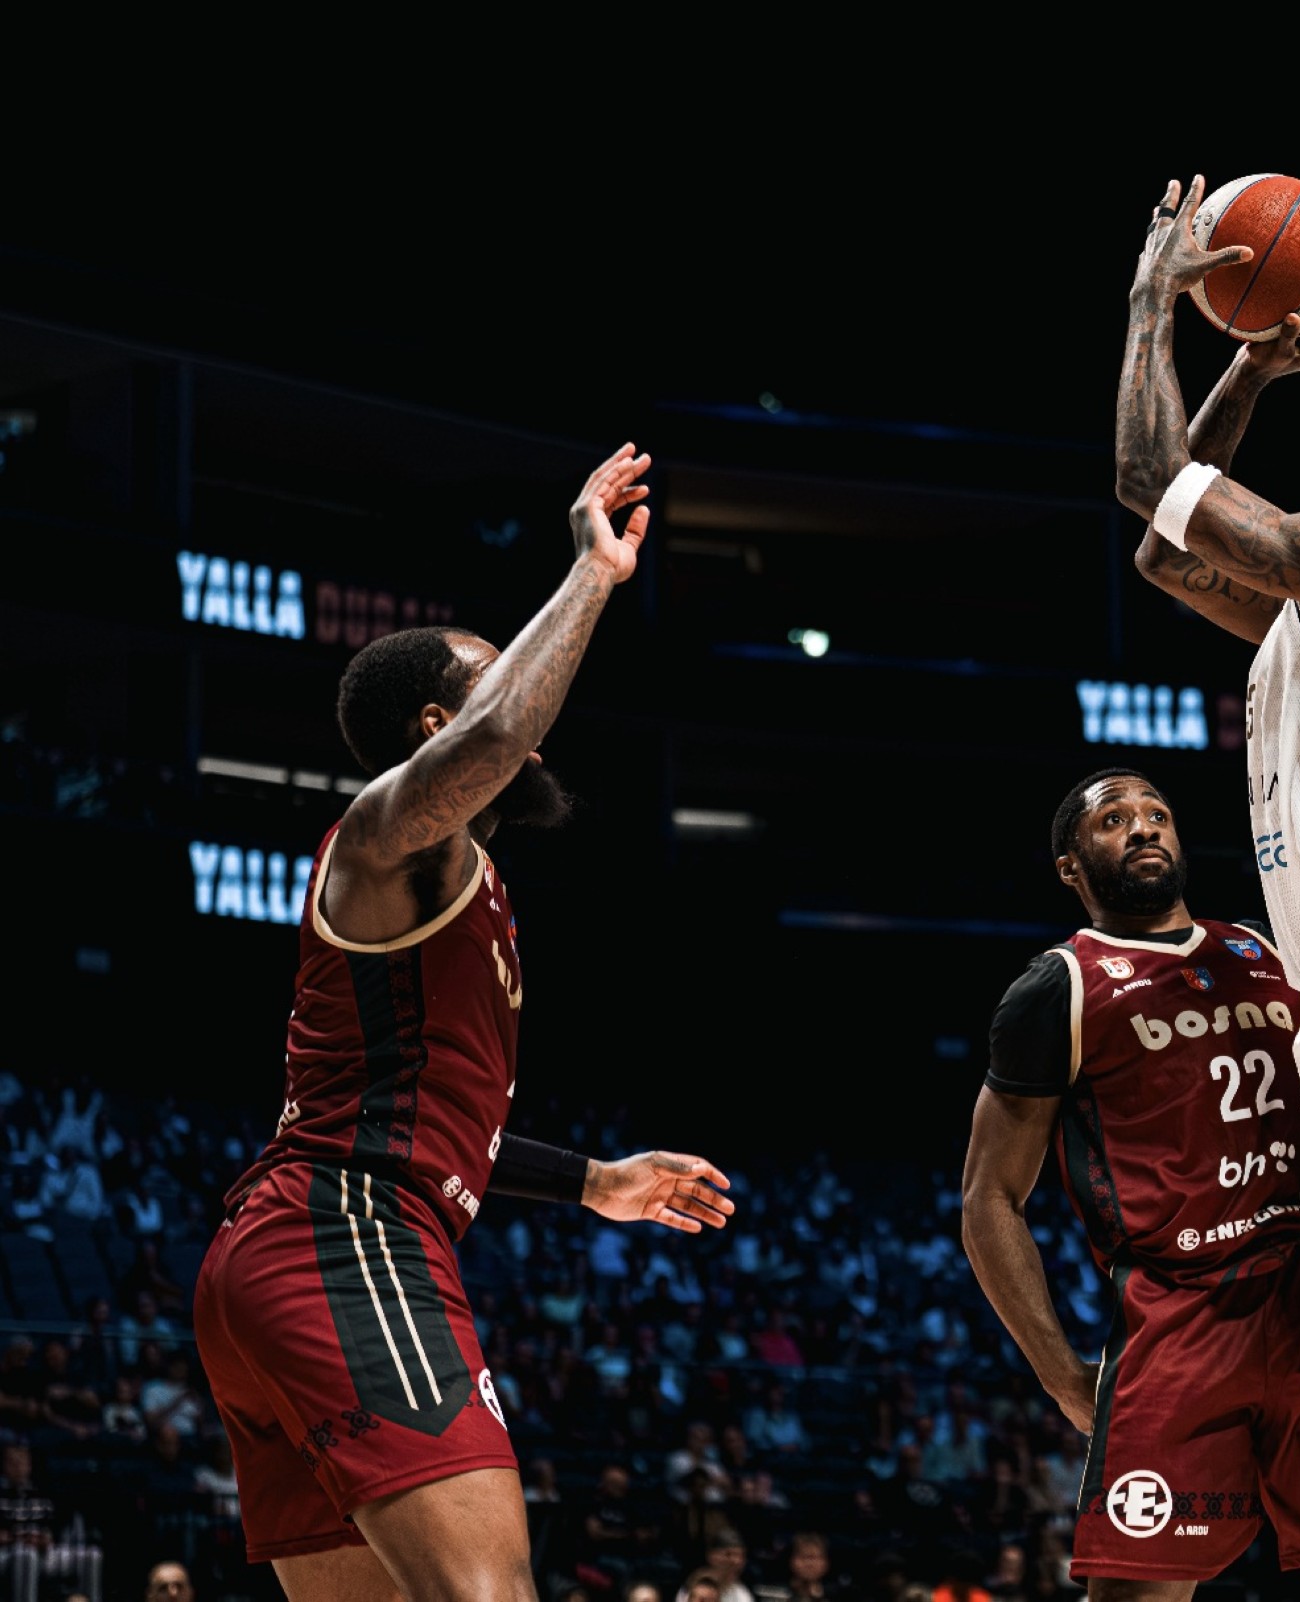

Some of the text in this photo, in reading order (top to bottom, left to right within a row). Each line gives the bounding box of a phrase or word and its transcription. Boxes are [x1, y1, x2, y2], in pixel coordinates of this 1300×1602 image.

[176, 549, 456, 648] YALLA DUB
[1075, 678, 1209, 752] YALLA
[1129, 1000, 1294, 1051] bosna
[1208, 1049, 1285, 1123] 22
[1218, 1151, 1266, 1189] bh
